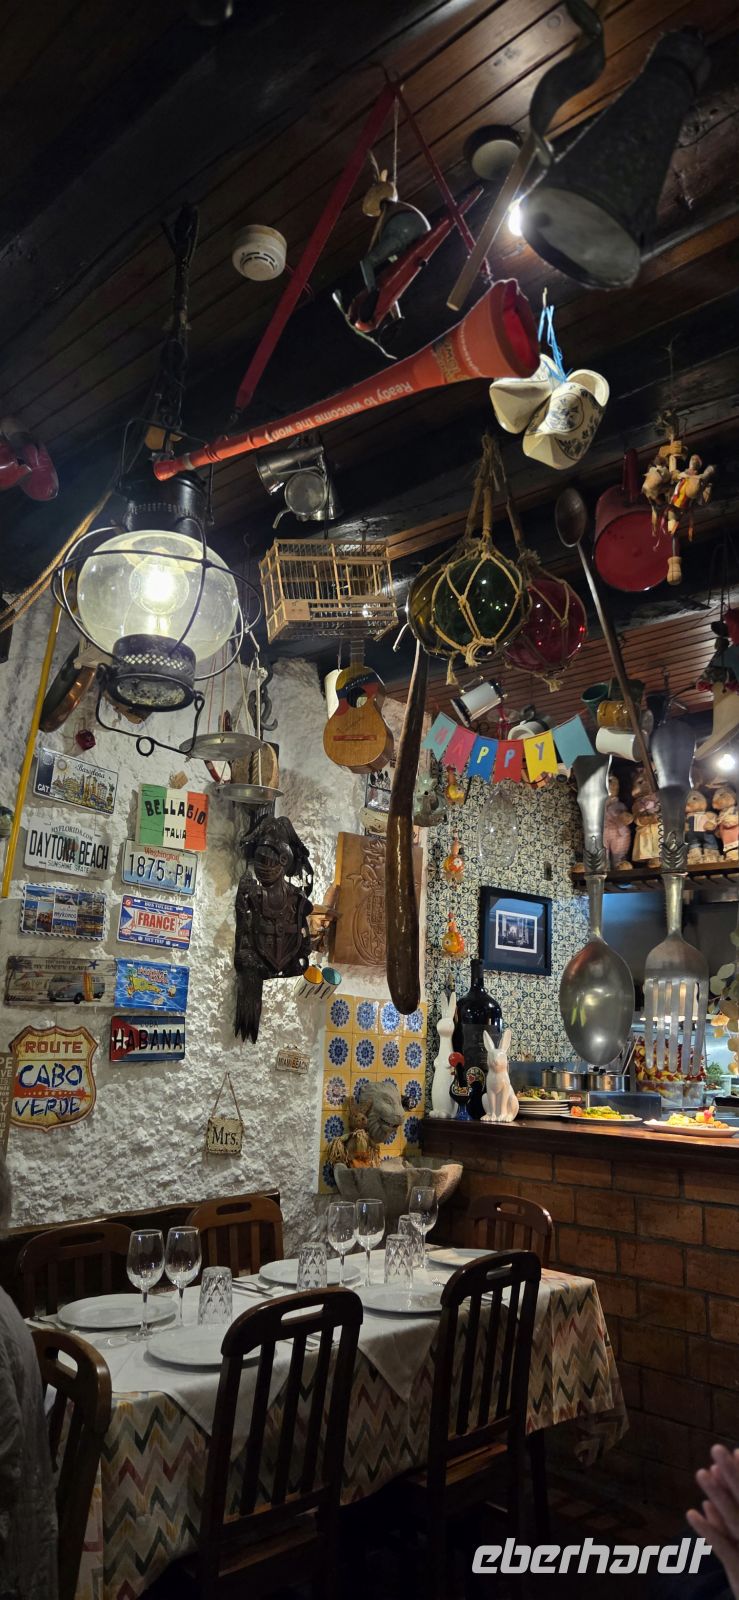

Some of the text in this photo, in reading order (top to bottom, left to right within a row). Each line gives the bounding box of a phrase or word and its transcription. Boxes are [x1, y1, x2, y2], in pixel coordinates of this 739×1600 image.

[363, 396, 378, 406] to
[376, 381, 414, 402] Ready
[314, 401, 362, 423] welcome
[433, 727, 546, 769] HAPPY
[144, 798, 207, 825] BELLAGIO
[29, 829, 110, 870] DAYTONA BEACH
[137, 911, 176, 931] FRANCE
[24, 1040, 84, 1054] ROUTE
[113, 1028, 183, 1051] HABANA
[18, 1062, 83, 1089] CABO
[14, 1097, 80, 1117] VERDE
[211, 1126, 239, 1146] Mrs.
